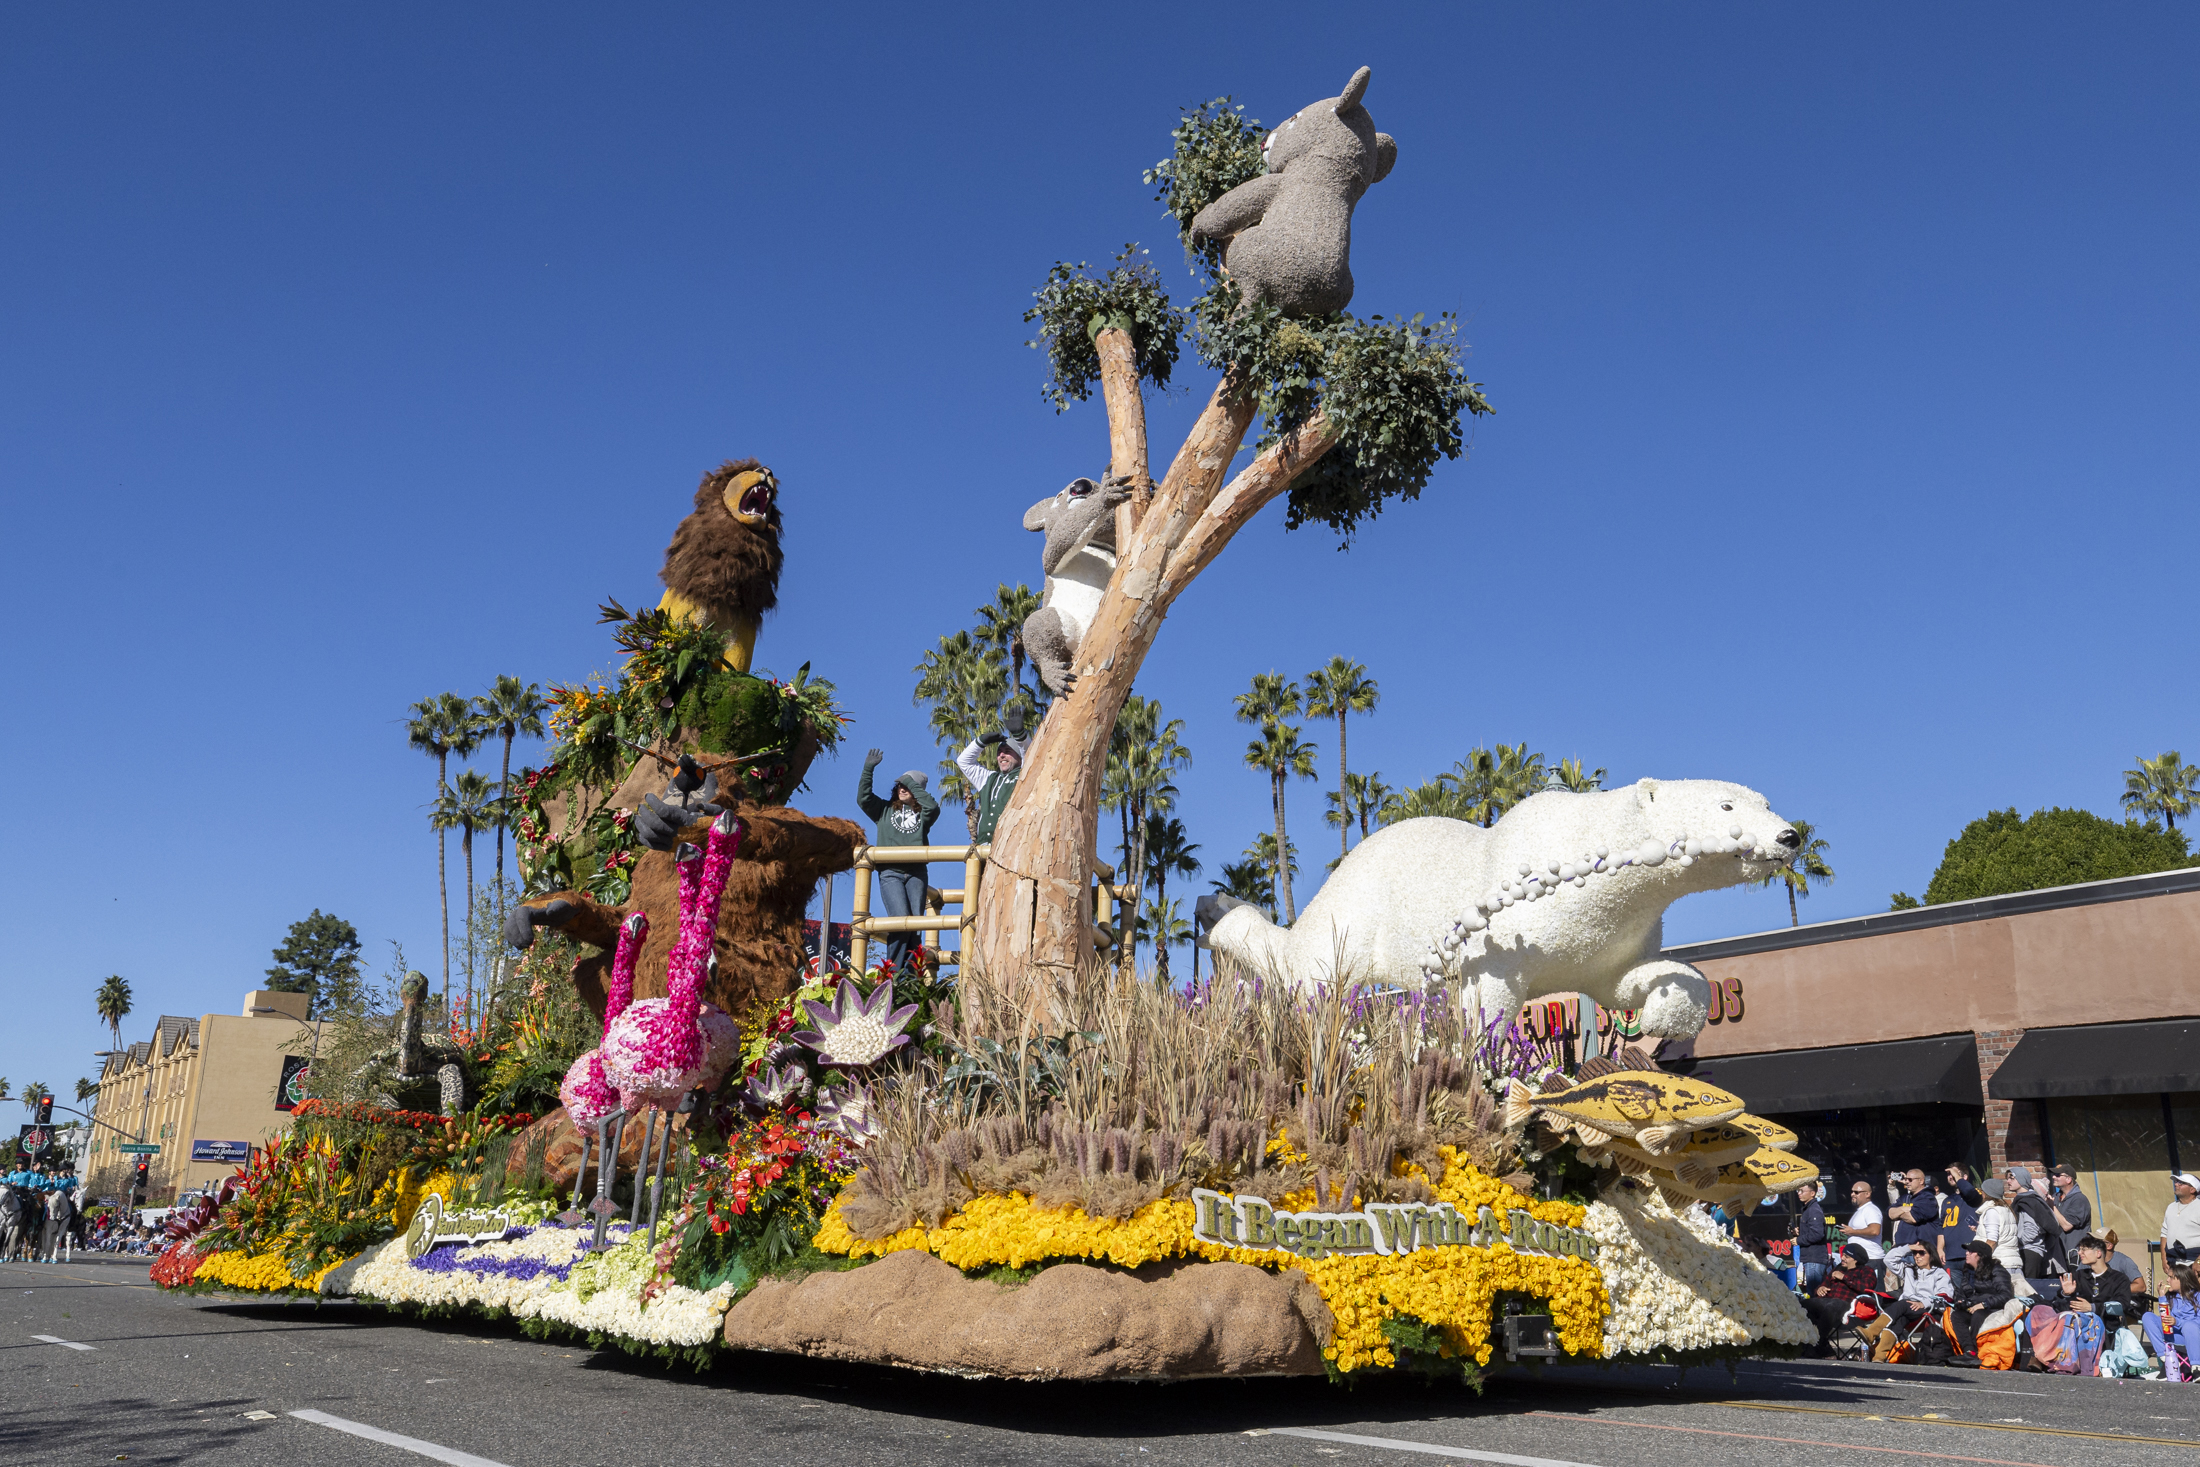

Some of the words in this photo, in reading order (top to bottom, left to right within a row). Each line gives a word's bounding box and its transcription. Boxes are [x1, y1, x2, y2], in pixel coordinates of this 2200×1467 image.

[283, 1060, 306, 1078] ROSE
[194, 1147, 220, 1155] Howard
[218, 1147, 245, 1156] Johnson
[435, 1216, 456, 1236] San
[456, 1213, 485, 1239] Diego
[481, 1213, 507, 1234] Zoo
[1198, 1194, 1238, 1241] It
[1241, 1201, 1374, 1259] Began
[1371, 1206, 1471, 1248] With
[1474, 1209, 1504, 1246] A
[1508, 1211, 1600, 1262] Roar
